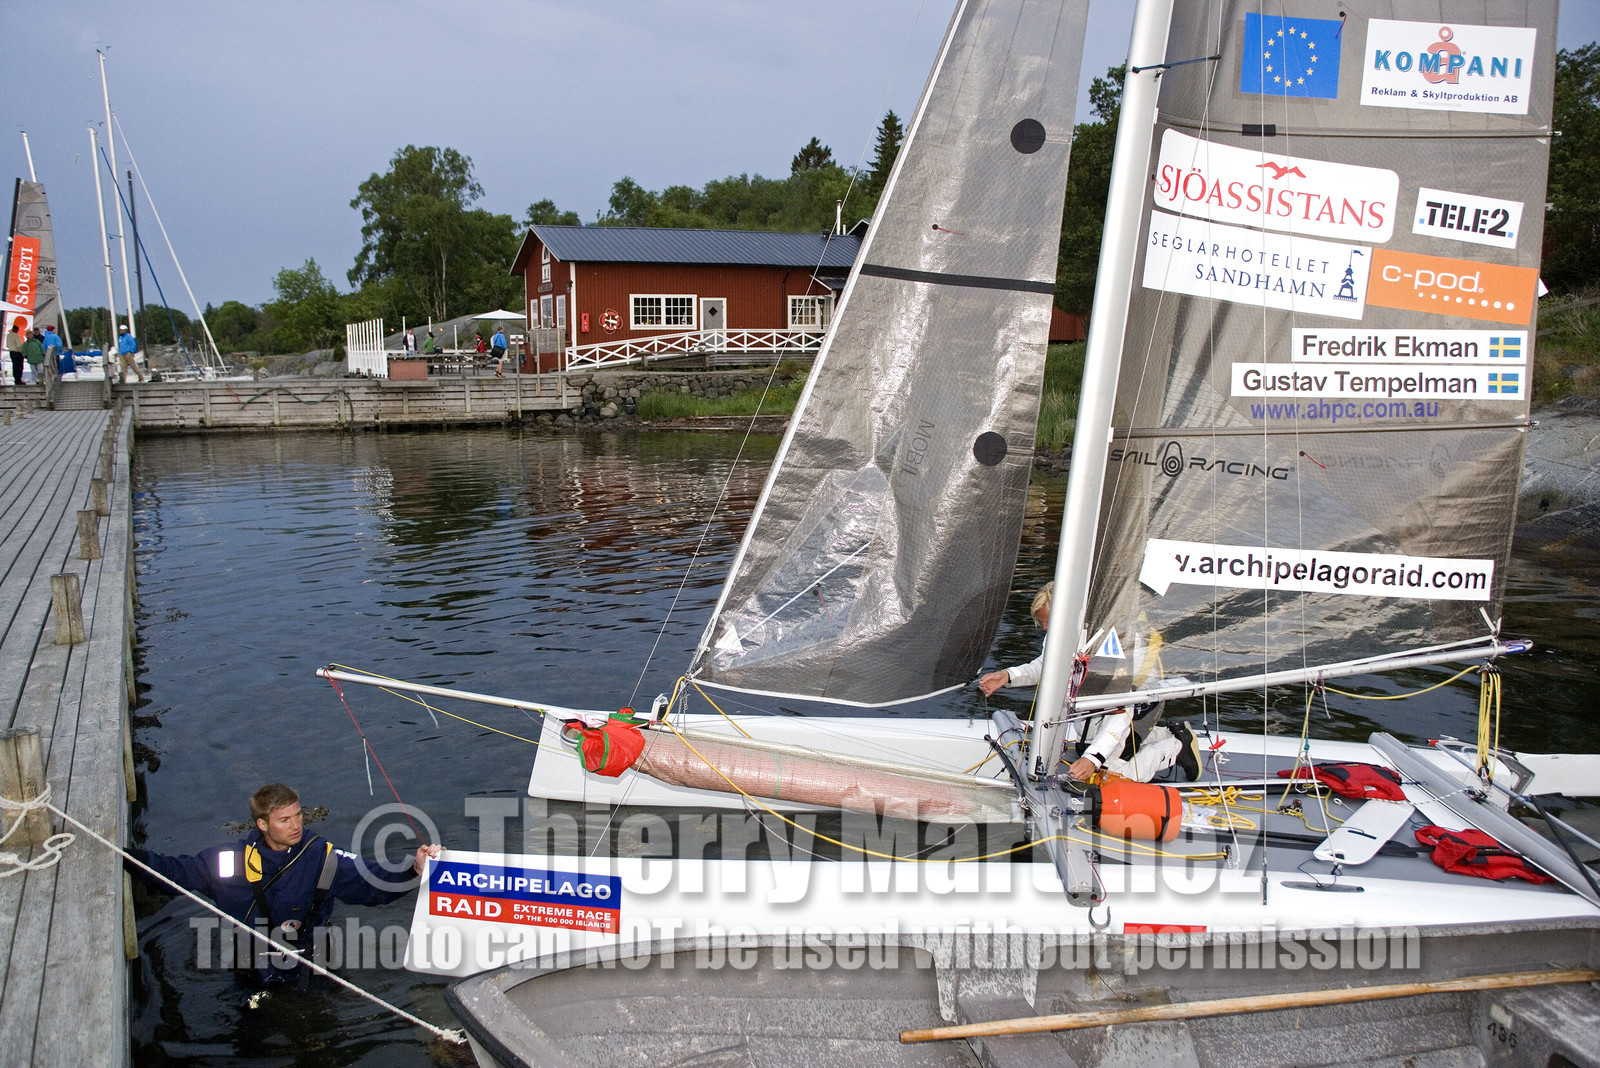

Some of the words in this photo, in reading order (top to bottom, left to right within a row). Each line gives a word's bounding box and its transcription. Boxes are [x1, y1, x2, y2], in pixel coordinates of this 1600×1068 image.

[1373, 49, 1522, 80] KOMPANI
[1371, 86, 1407, 98] Reklam
[1410, 89, 1418, 98] &
[1422, 90, 1500, 103] Skyltproduktion
[1503, 95, 1518, 103] AB
[1159, 164, 1386, 229] SJÖASSISTANS
[1152, 231, 1329, 274] SEGLARHOTELLET
[15, 246, 34, 305] SOGETI
[37, 265, 57, 276] SWE
[1194, 262, 1327, 300] SANDHAMN
[1302, 335, 1386, 358] Fredrik
[1394, 336, 1479, 358] Ekman
[1242, 369, 1327, 392] Gustav
[1333, 371, 1478, 398] Tempelman
[1250, 400, 1439, 423] www.ahpc.com.au
[1109, 449, 1158, 466] SAIL
[1188, 457, 1290, 480] RACING
[437, 870, 612, 900] ARCHIPELAGO
[436, 896, 502, 917] RAID
[513, 904, 573, 917] EXTREME
[576, 909, 612, 921] RACE
[560, 918, 574, 926] 000
[576, 920, 611, 929] ISLANDS
